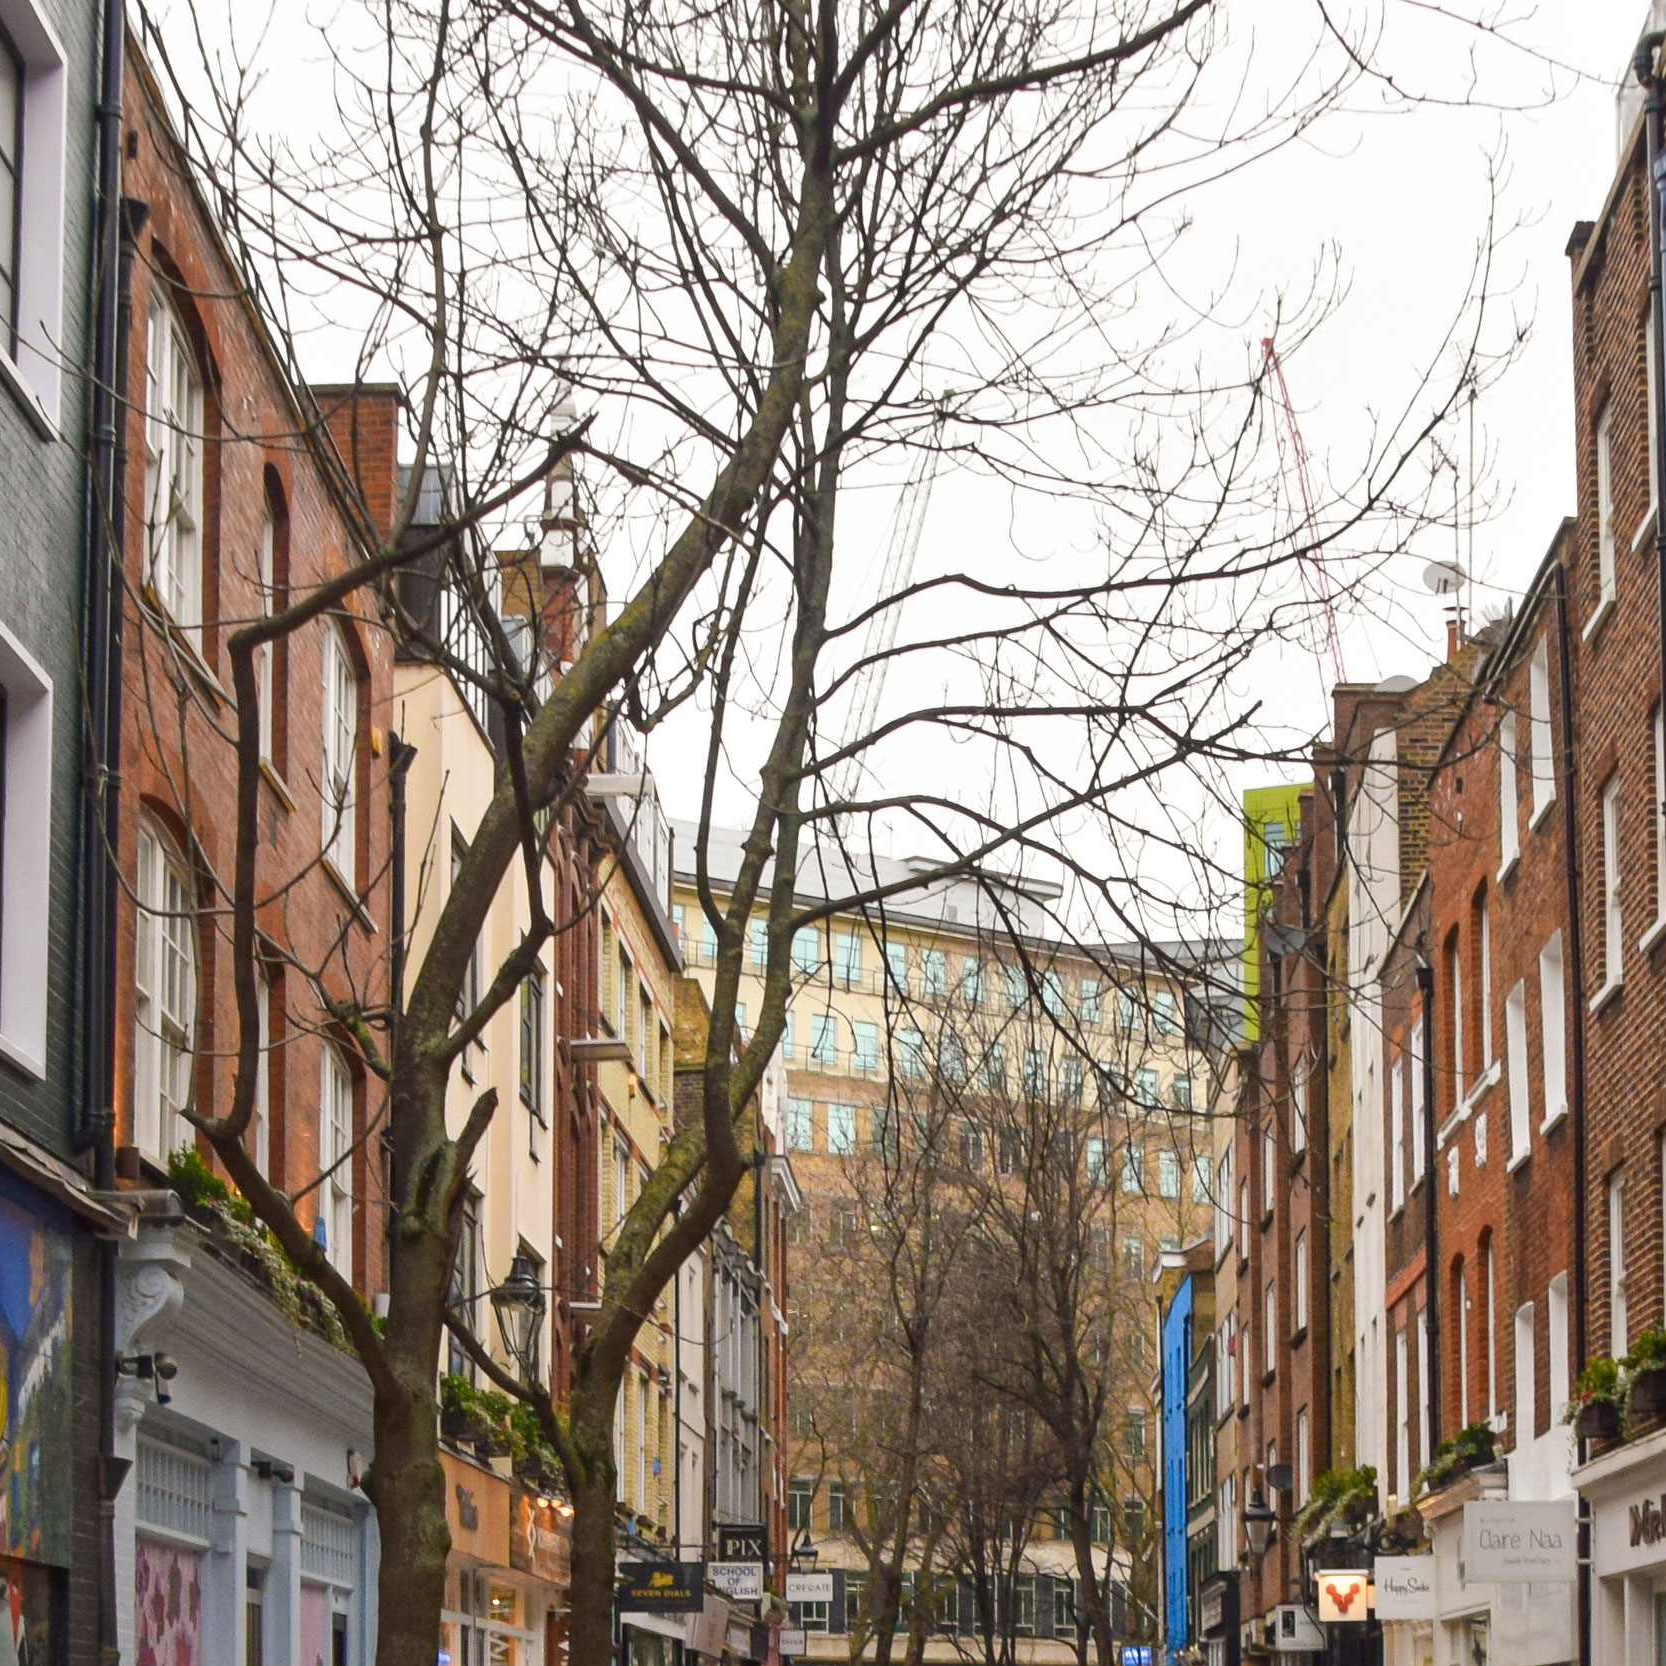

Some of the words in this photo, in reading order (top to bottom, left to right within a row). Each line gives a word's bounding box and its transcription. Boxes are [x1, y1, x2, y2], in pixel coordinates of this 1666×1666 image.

[726, 1539, 762, 1556] PIX
[712, 1567, 757, 1577] SCHOOL
[727, 1577, 741, 1587] OF
[1384, 1576, 1408, 1597] Happy
[631, 1589, 661, 1598] SEVEN
[664, 1588, 692, 1597] DIALS
[718, 1586, 758, 1596] NGLISH
